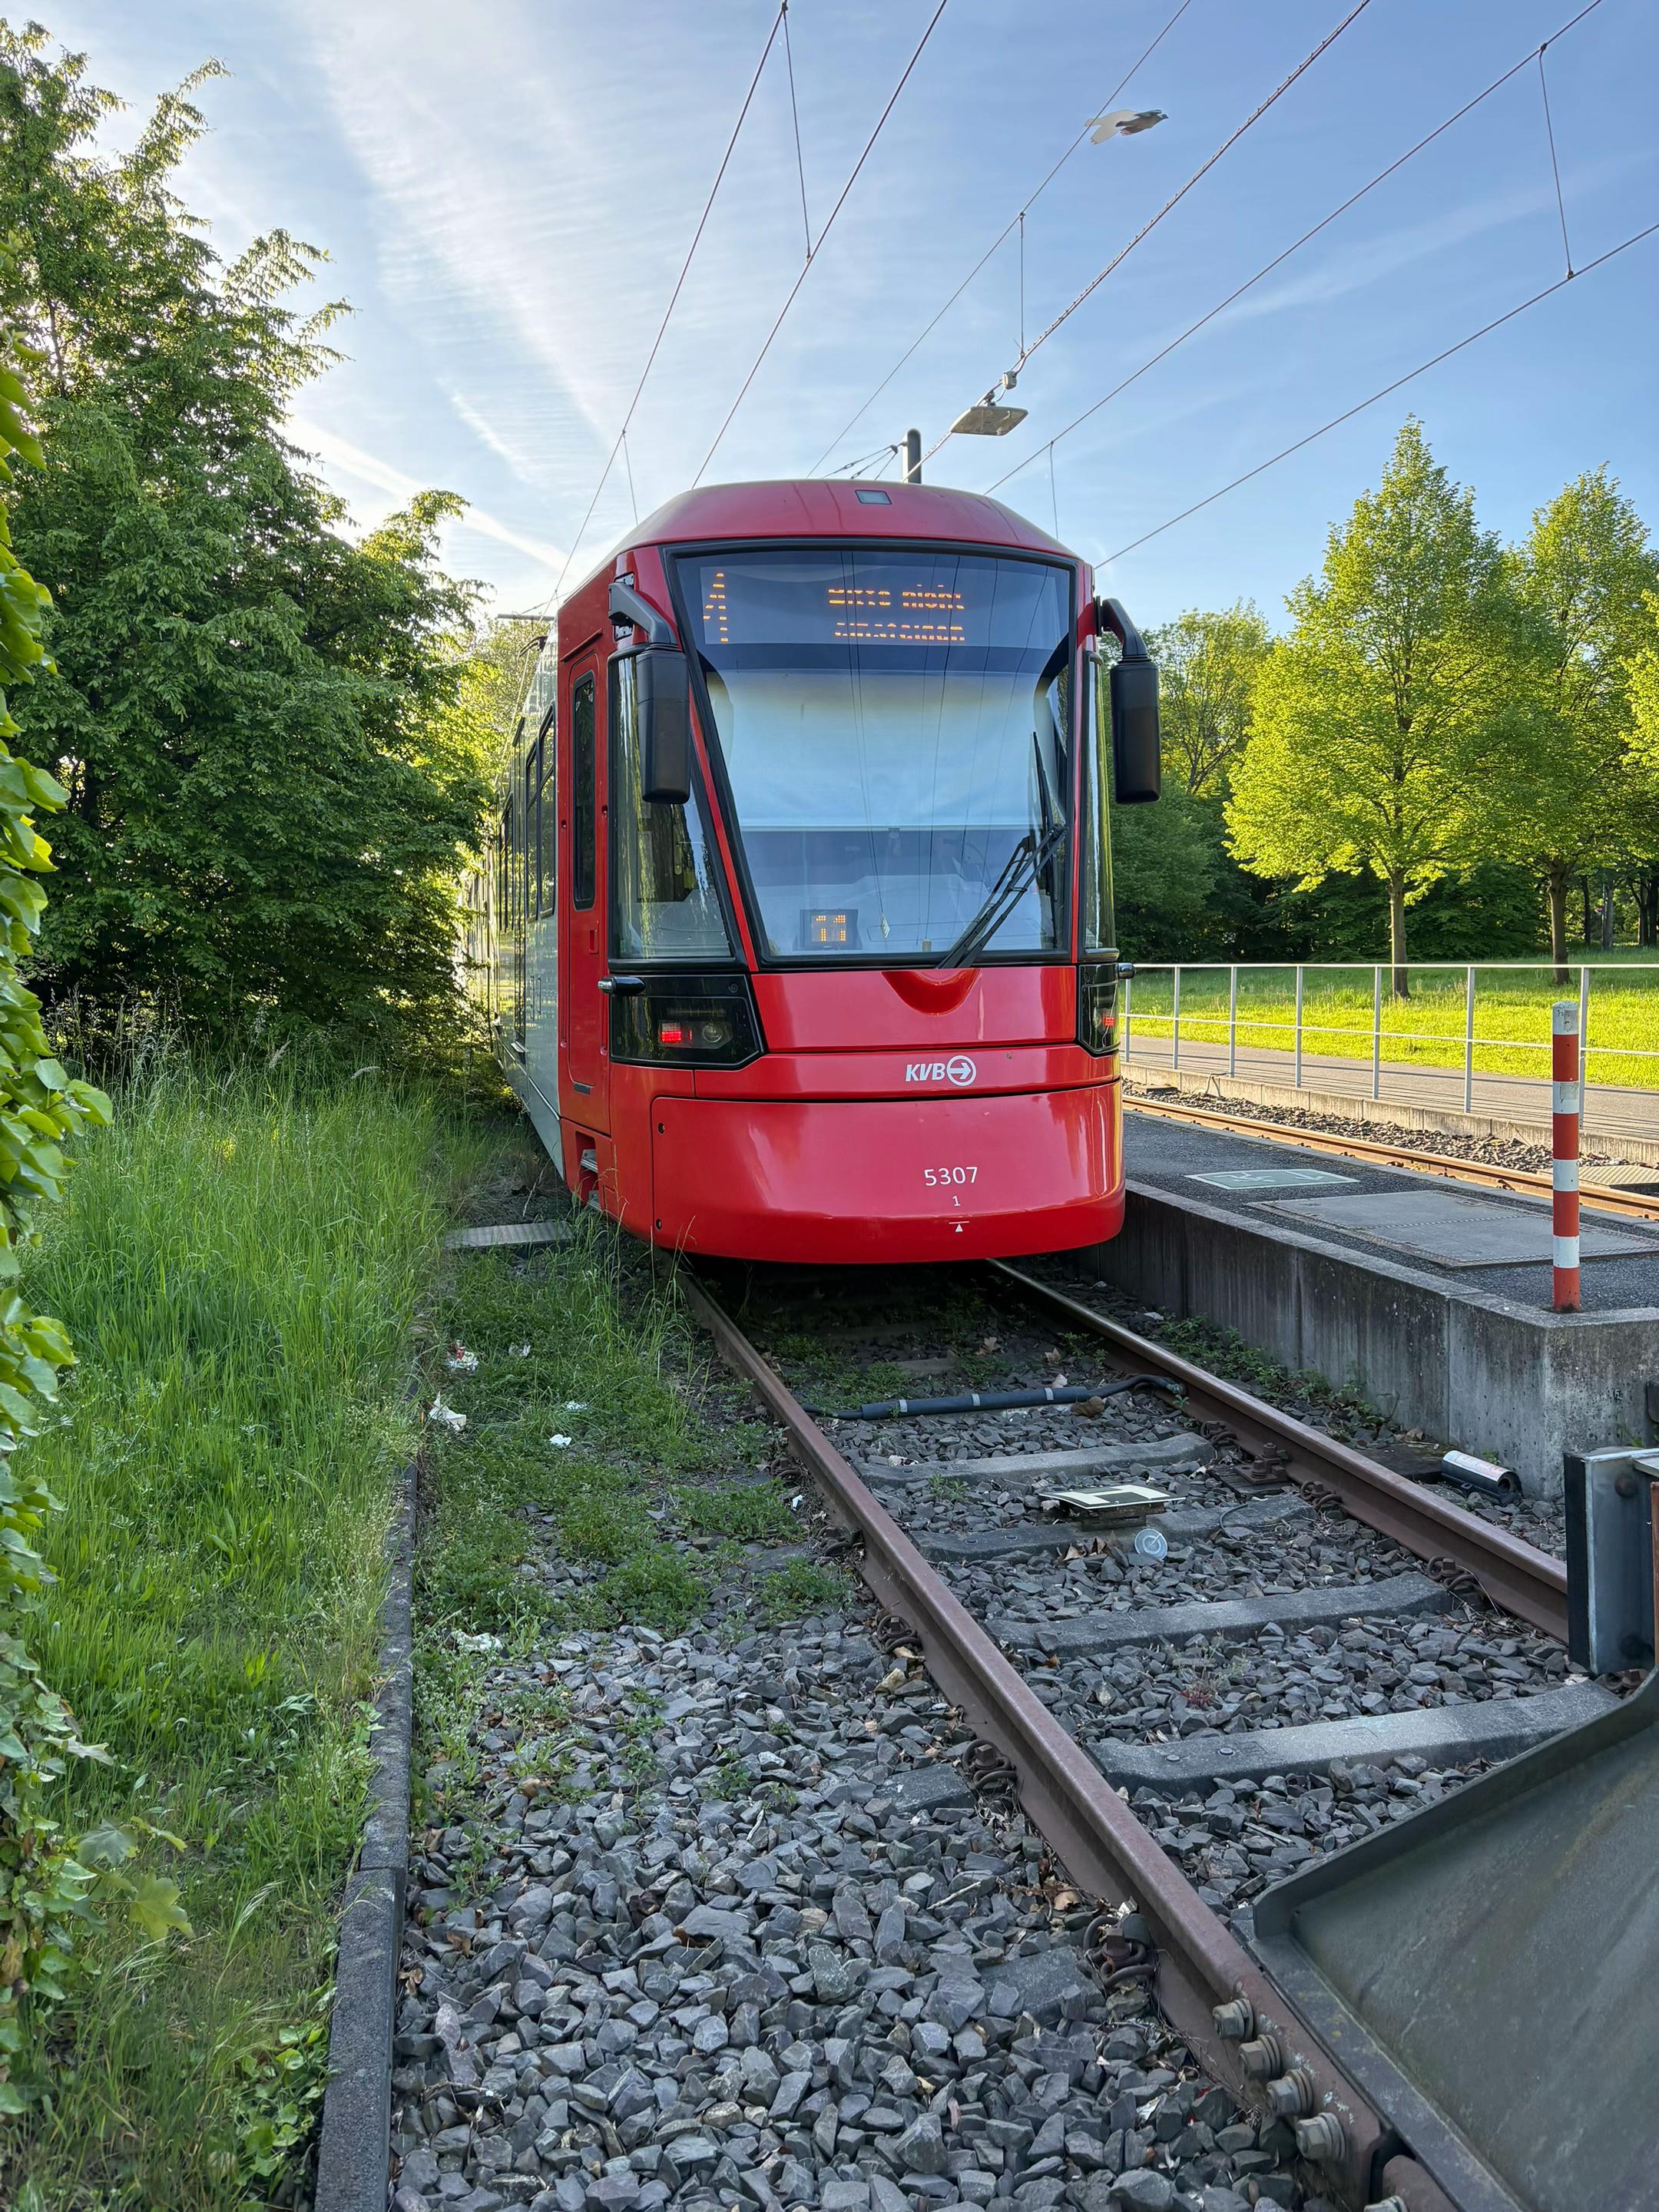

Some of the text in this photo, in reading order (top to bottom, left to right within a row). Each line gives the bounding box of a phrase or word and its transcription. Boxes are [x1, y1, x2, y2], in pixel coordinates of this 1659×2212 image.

[905, 1063, 945, 1082] KVB
[924, 1166, 978, 1186] 5307
[952, 1195, 961, 1207] 1
